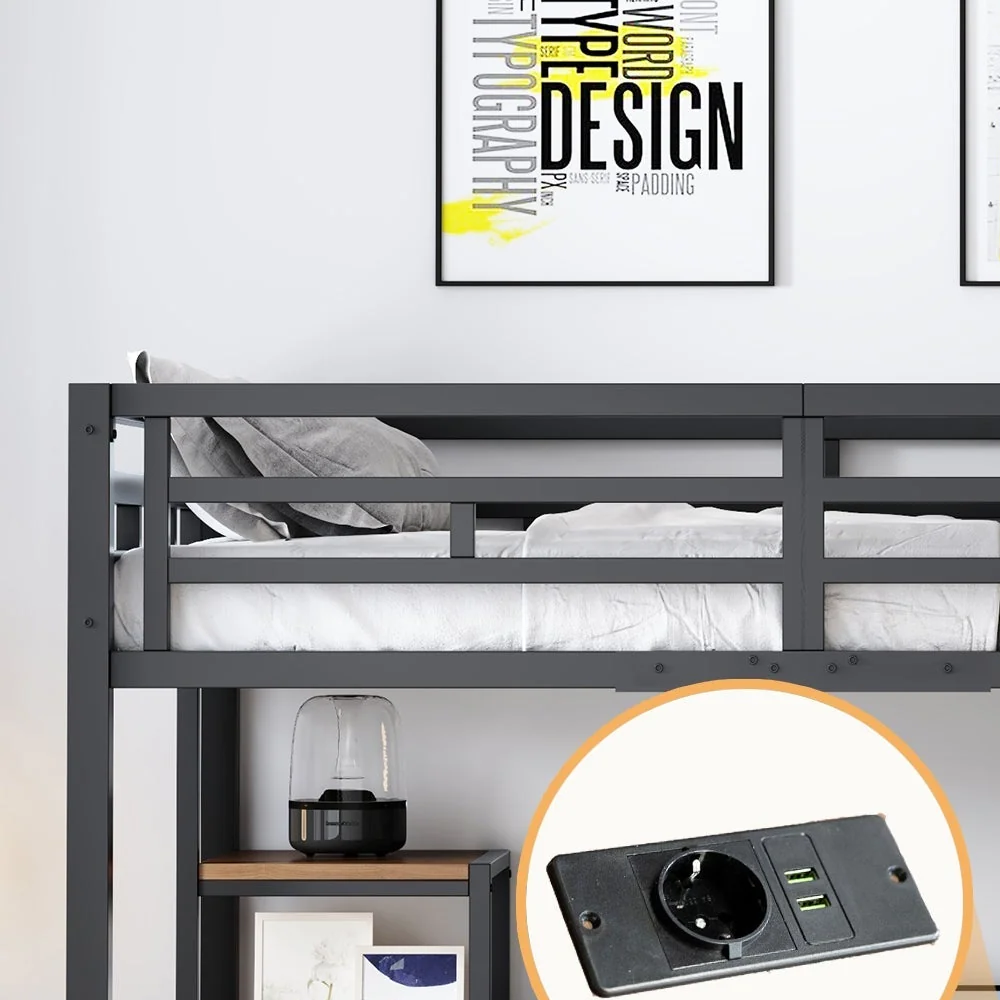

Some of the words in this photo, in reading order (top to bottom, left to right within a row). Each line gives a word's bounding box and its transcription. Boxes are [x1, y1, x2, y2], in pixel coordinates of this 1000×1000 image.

[623, 4, 674, 80] WORD
[680, 0, 718, 35] ONT
[473, 14, 537, 216] TYPOGRAPHY
[541, 81, 743, 170] DESIGN
[541, 173, 567, 189] PX
[632, 173, 695, 195] PADDING
